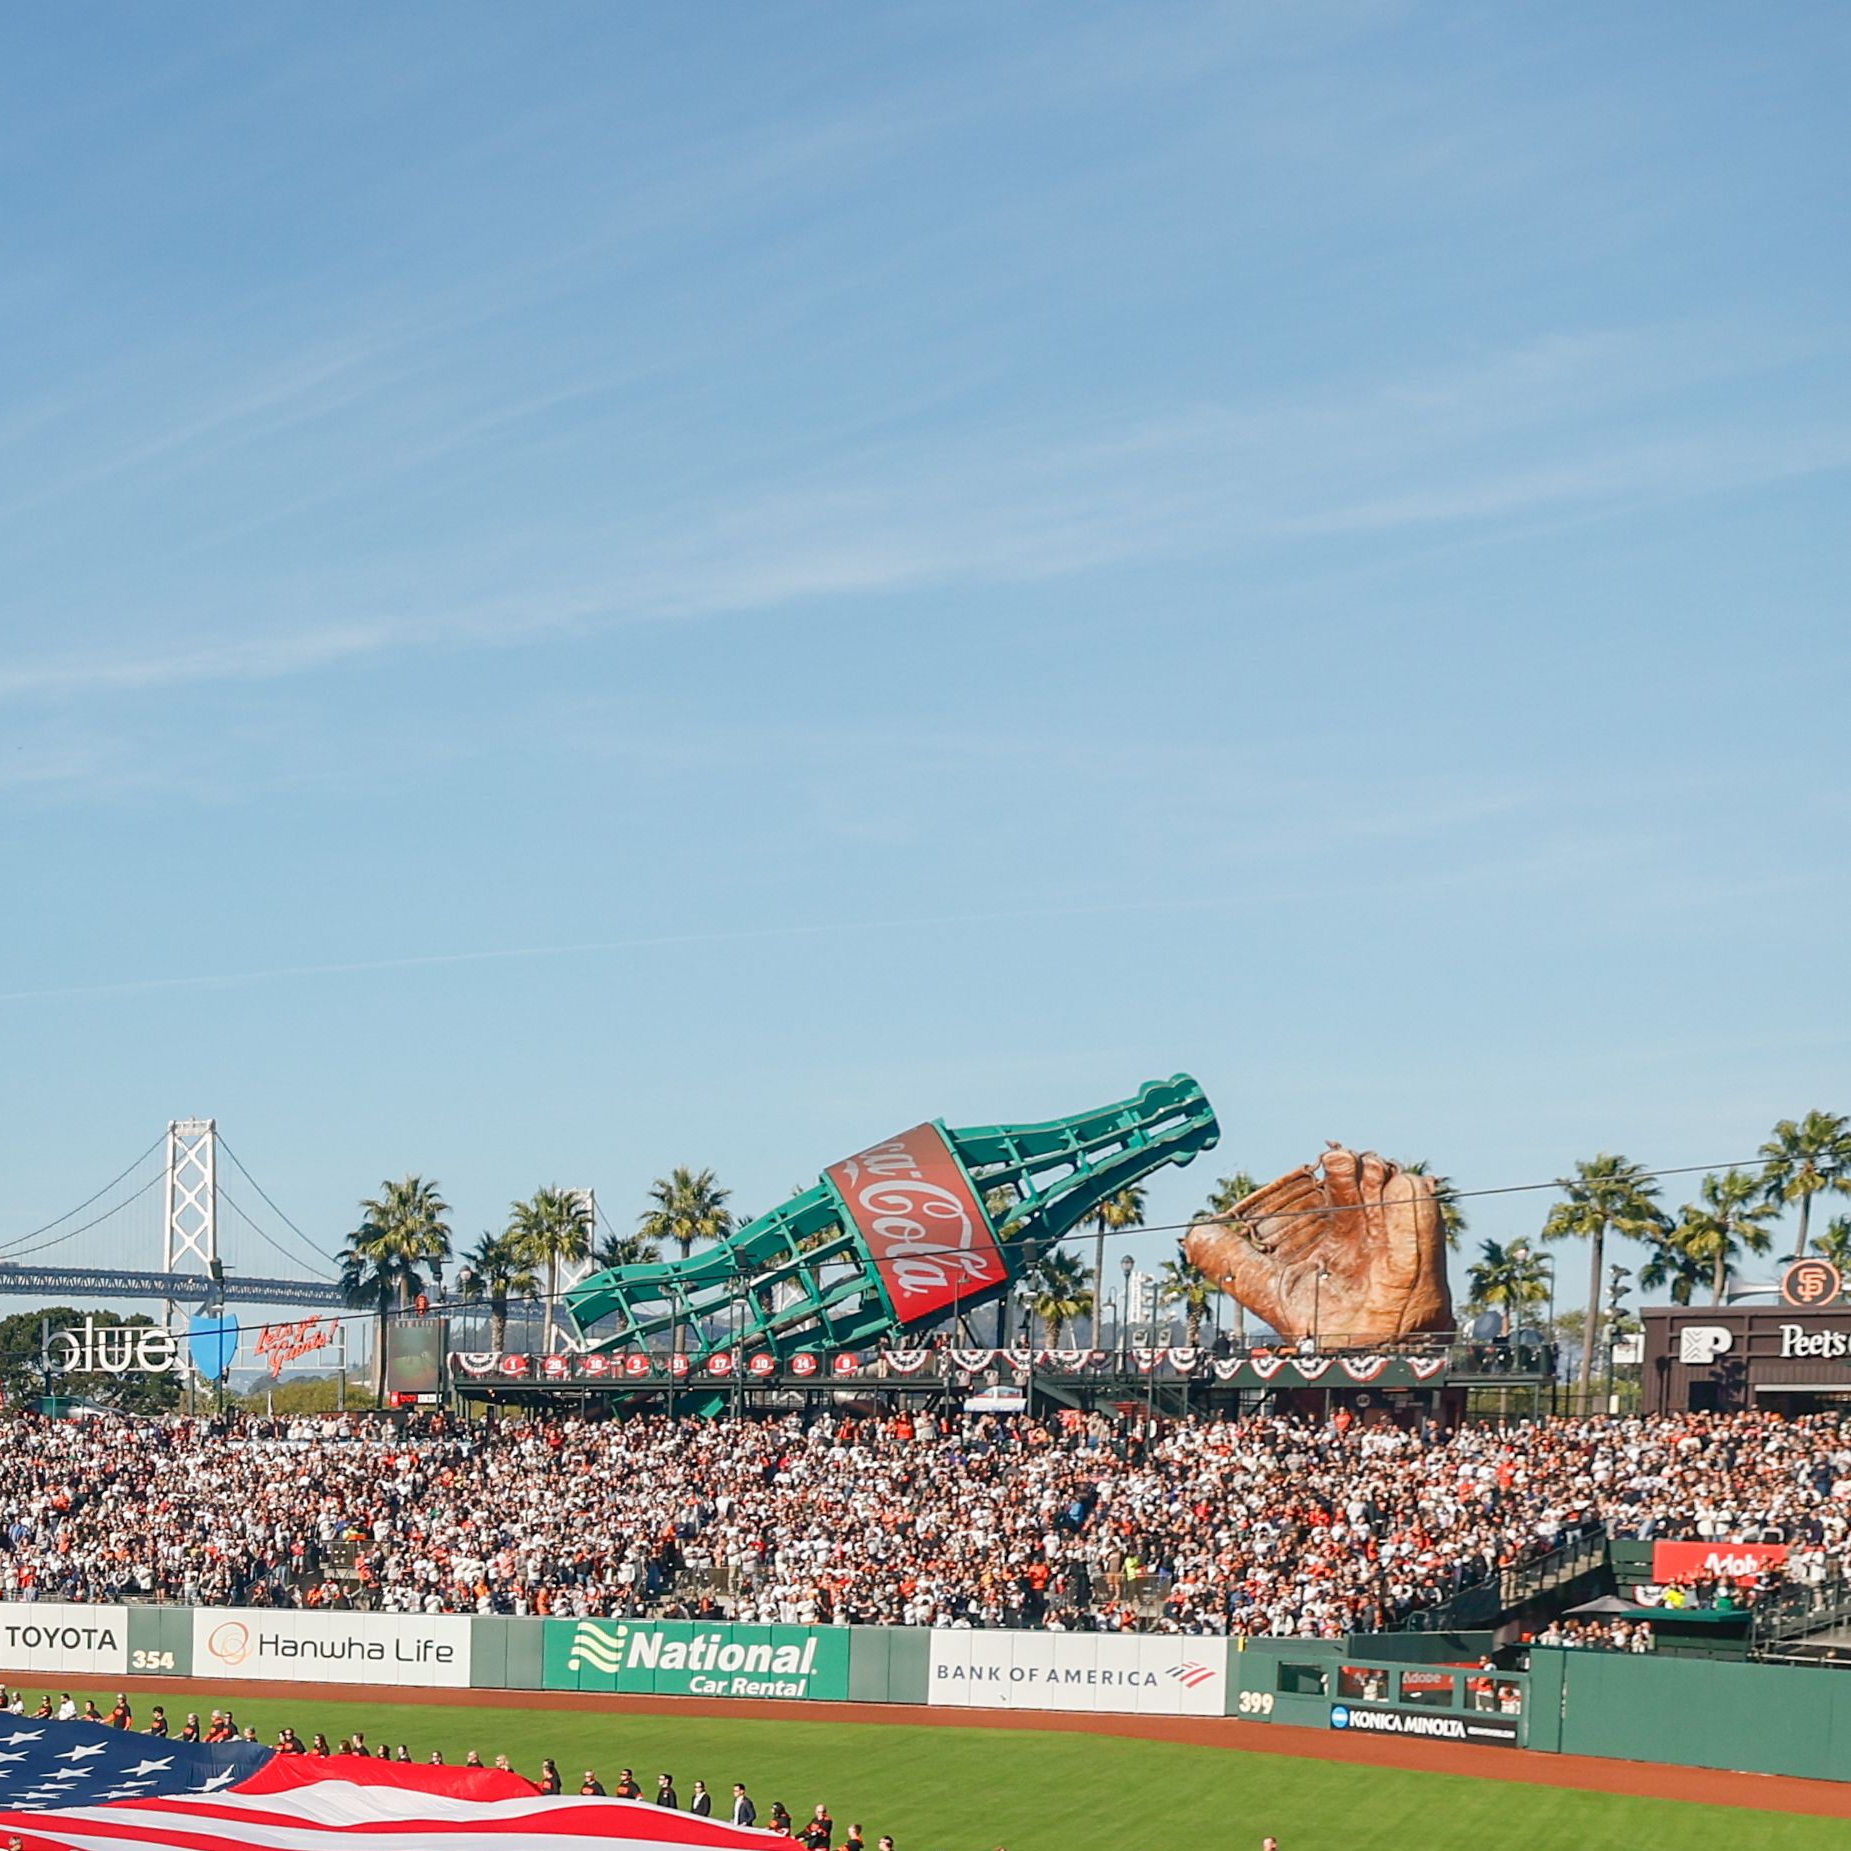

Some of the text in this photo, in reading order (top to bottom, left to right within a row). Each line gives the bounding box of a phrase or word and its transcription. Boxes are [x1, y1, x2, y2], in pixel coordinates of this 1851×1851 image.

[42, 1317, 178, 1373] blue
[509, 1359, 517, 1369] 1
[633, 1359, 641, 1369] 2
[714, 1359, 726, 1369] 17
[755, 1358, 769, 1369] 10
[797, 1358, 810, 1368] 14
[5, 1626, 117, 1650] TOYOTA
[259, 1633, 454, 1662] Hanwha Life
[132, 1650, 175, 1669] 354
[626, 1632, 818, 1675] National
[689, 1676, 806, 1697] Car Rental
[937, 1664, 1158, 1687] BANK OF AMERICA
[1239, 1691, 1274, 1715] 399
[1349, 1711, 1403, 1732] KONICA
[1404, 1716, 1466, 1738] MINOLTA
